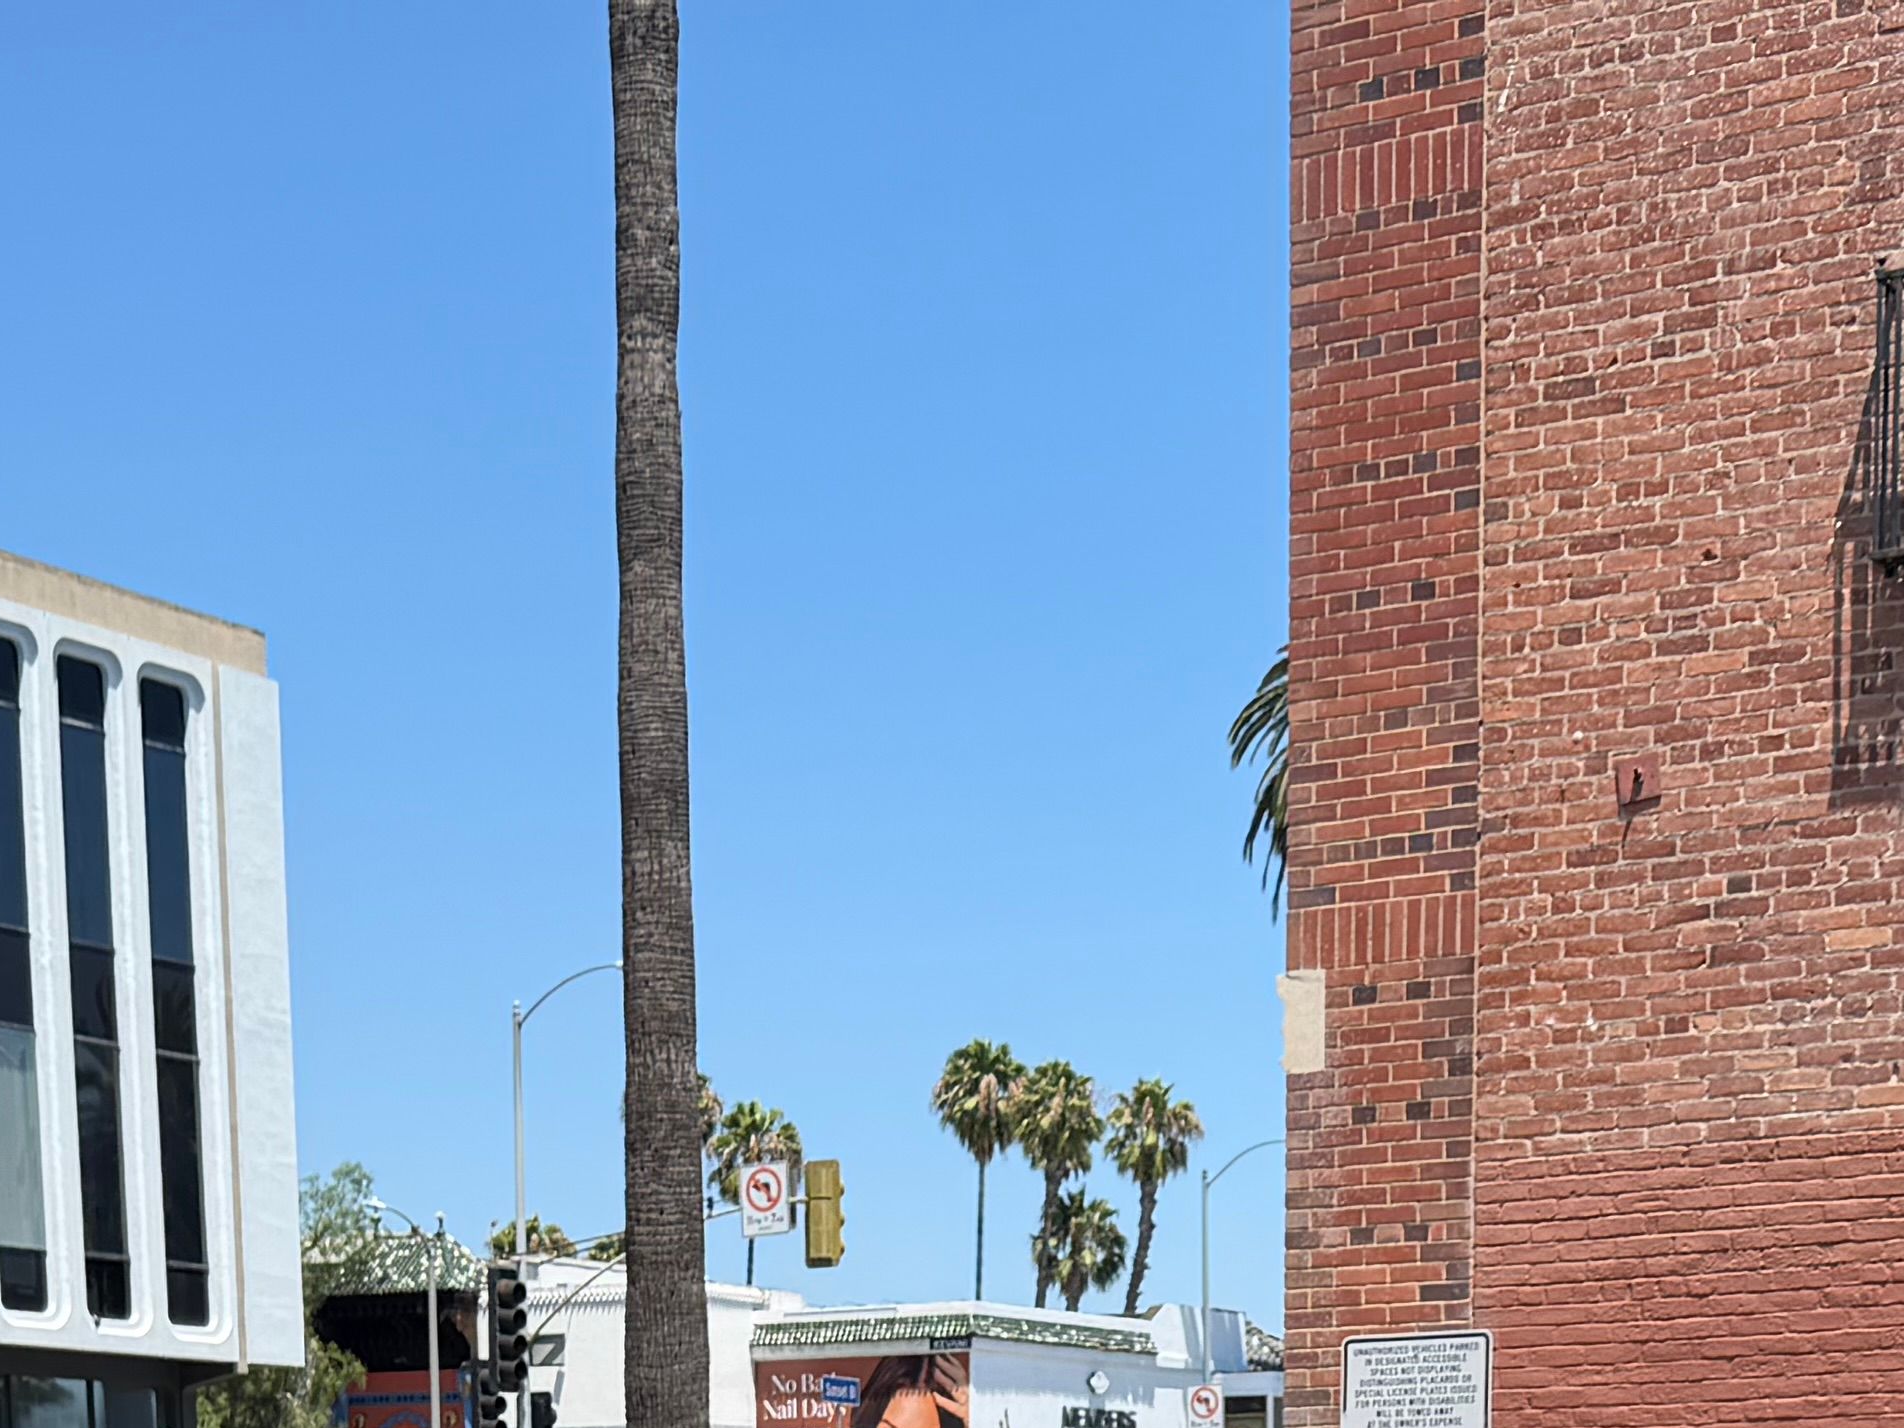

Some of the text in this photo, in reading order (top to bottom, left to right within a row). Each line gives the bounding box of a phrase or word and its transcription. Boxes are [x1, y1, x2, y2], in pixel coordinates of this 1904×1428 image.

[1411, 1343, 1447, 1353] VEHICLES
[1422, 1353, 1467, 1363] ACCESSIBLE
[1370, 1364, 1462, 1376] SPACES NOT DISPLAYING
[771, 1374, 797, 1395] No
[1419, 1374, 1459, 1385] PLACARDS
[1355, 1389, 1384, 1398] SPECIAL
[1387, 1387, 1417, 1397] LICENSE
[1419, 1385, 1448, 1395] PLATES
[763, 1397, 798, 1420] Nail
[1355, 1399, 1370, 1408] FOR
[1372, 1398, 1406, 1407] PERSONS
[1409, 1397, 1426, 1406] WITH
[1376, 1406, 1454, 1418] WILL BE TOWED AWAY
[1367, 1420, 1376, 1428] AT
[1378, 1419, 1392, 1428] THE
[1429, 1416, 1463, 1427] EXPENSE
